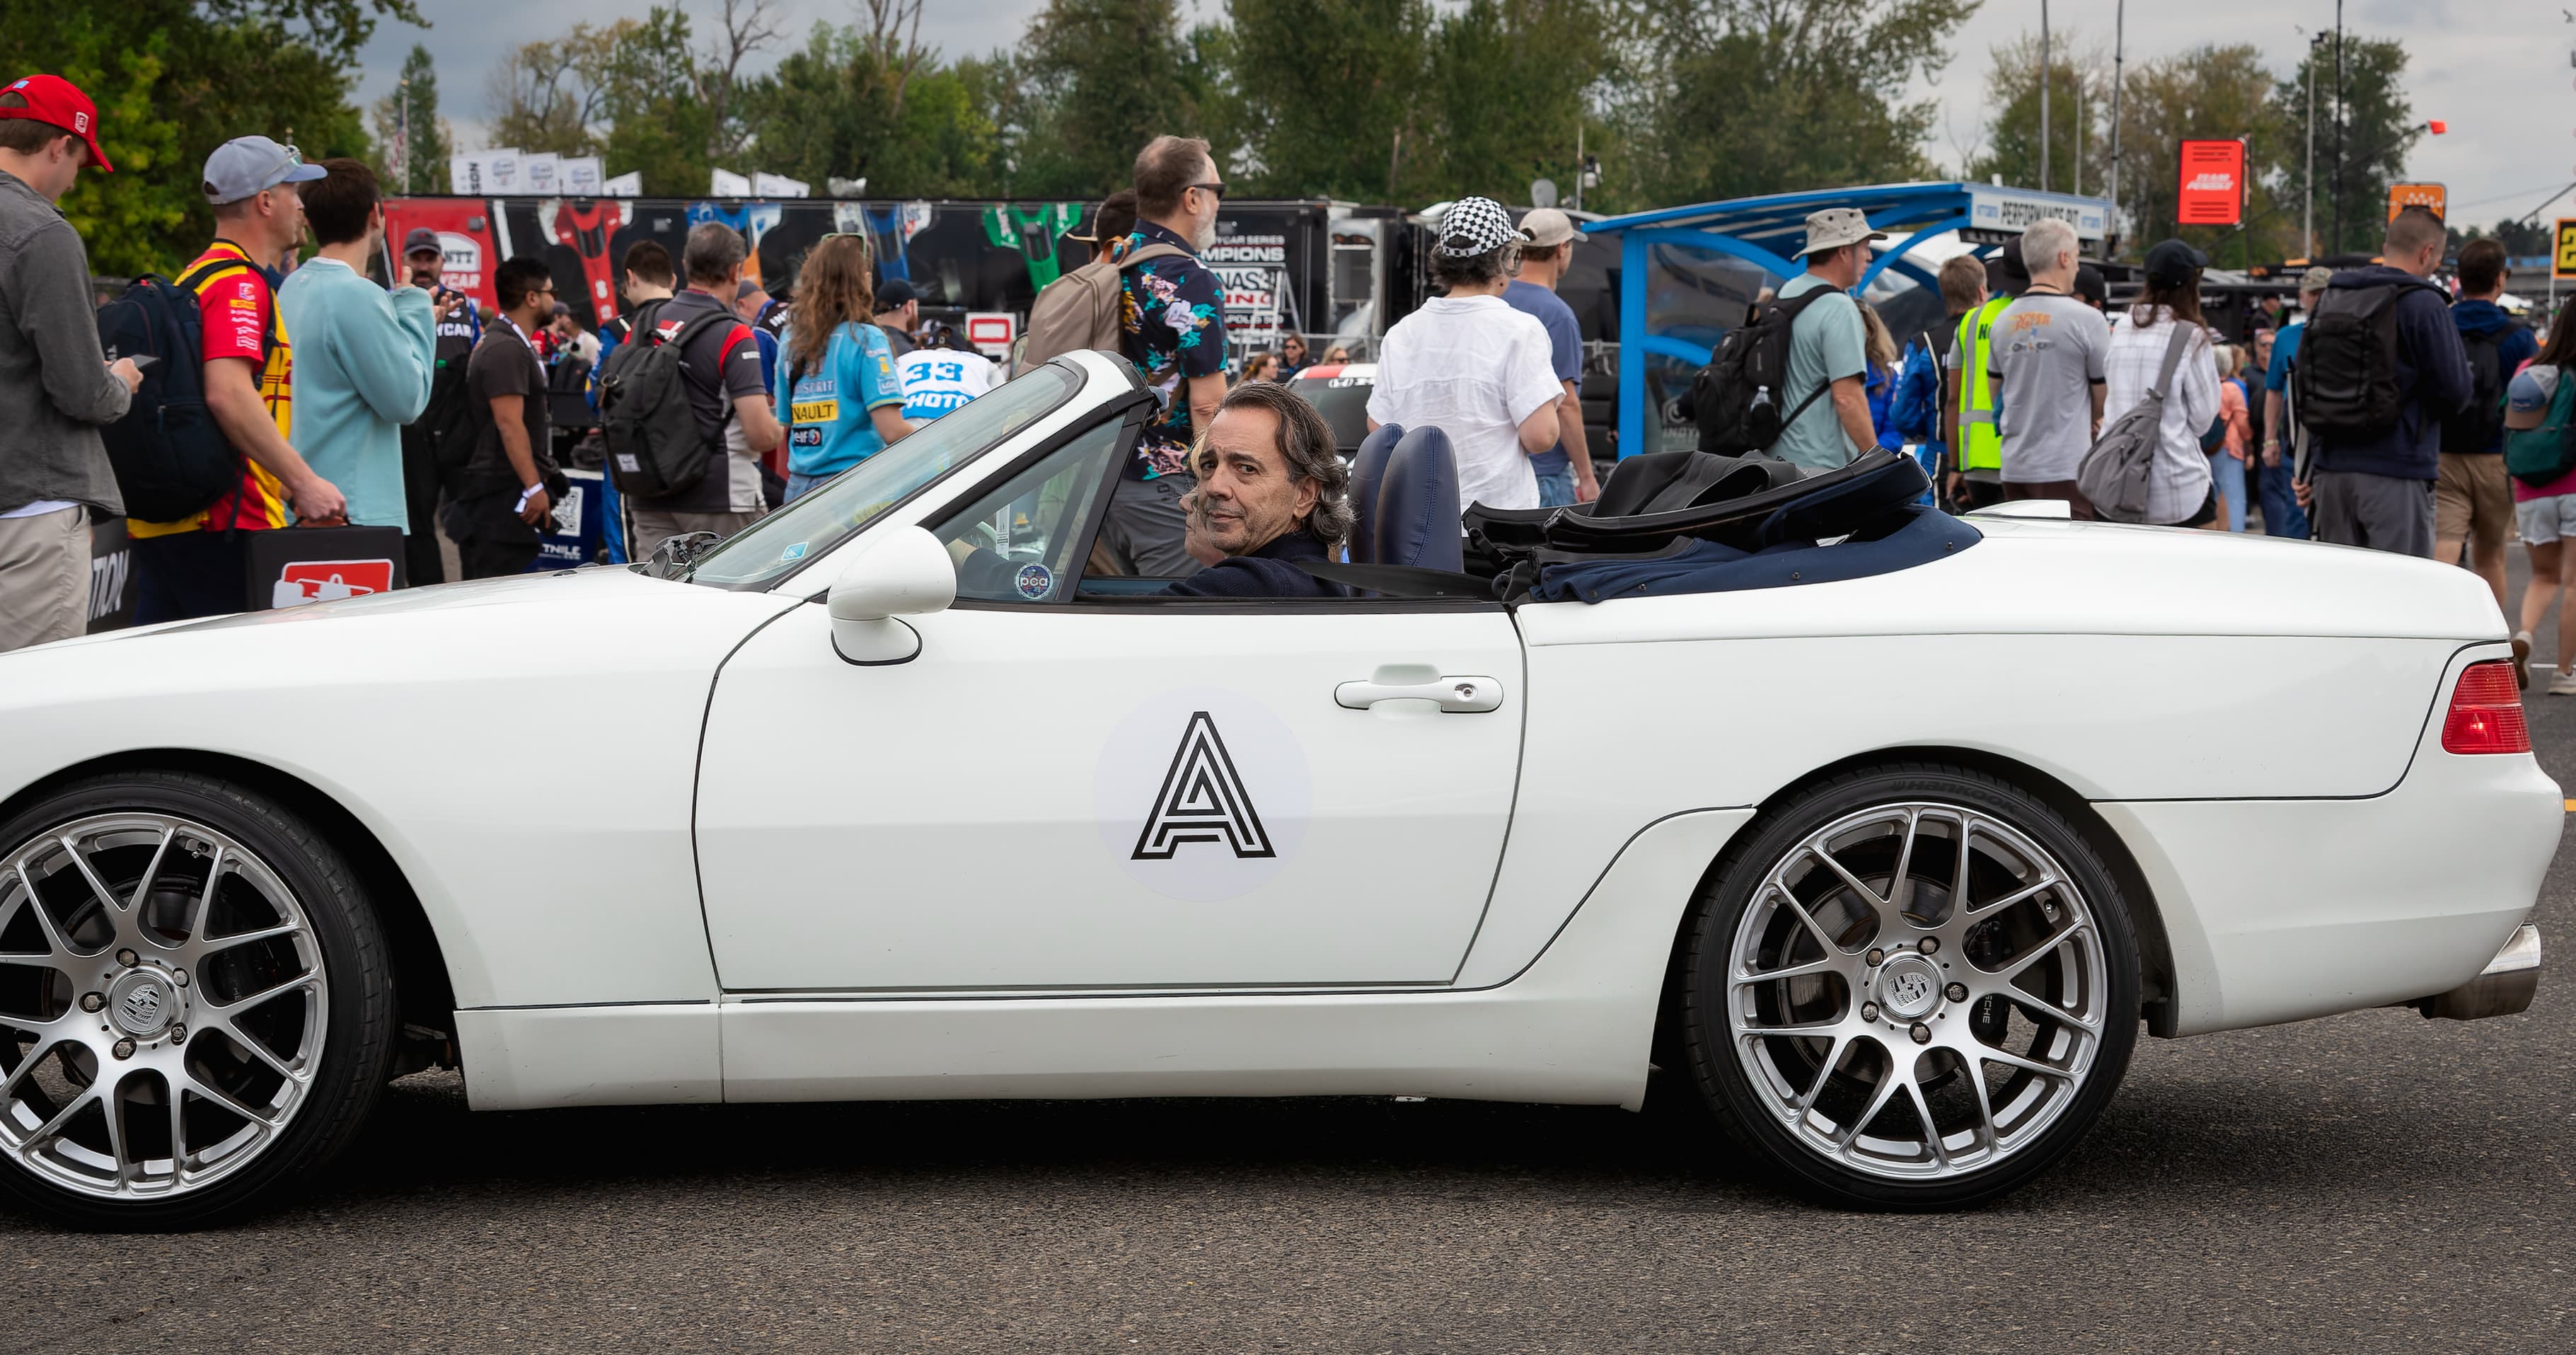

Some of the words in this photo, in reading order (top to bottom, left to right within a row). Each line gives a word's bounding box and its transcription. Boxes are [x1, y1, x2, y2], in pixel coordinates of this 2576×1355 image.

[1215, 235, 1245, 245] YCAR
[1246, 235, 1285, 245] SERIES
[1200, 247, 1285, 262] MPIONS
[439, 273, 481, 289] YCAR
[436, 323, 473, 337] YCAR
[905, 362, 964, 387] 33
[906, 393, 971, 408] HOTO
[792, 403, 834, 421] NAULT
[1020, 577, 1049, 587] pca
[1130, 710, 1277, 860] A
[1982, 994, 1992, 1024] SCHE
